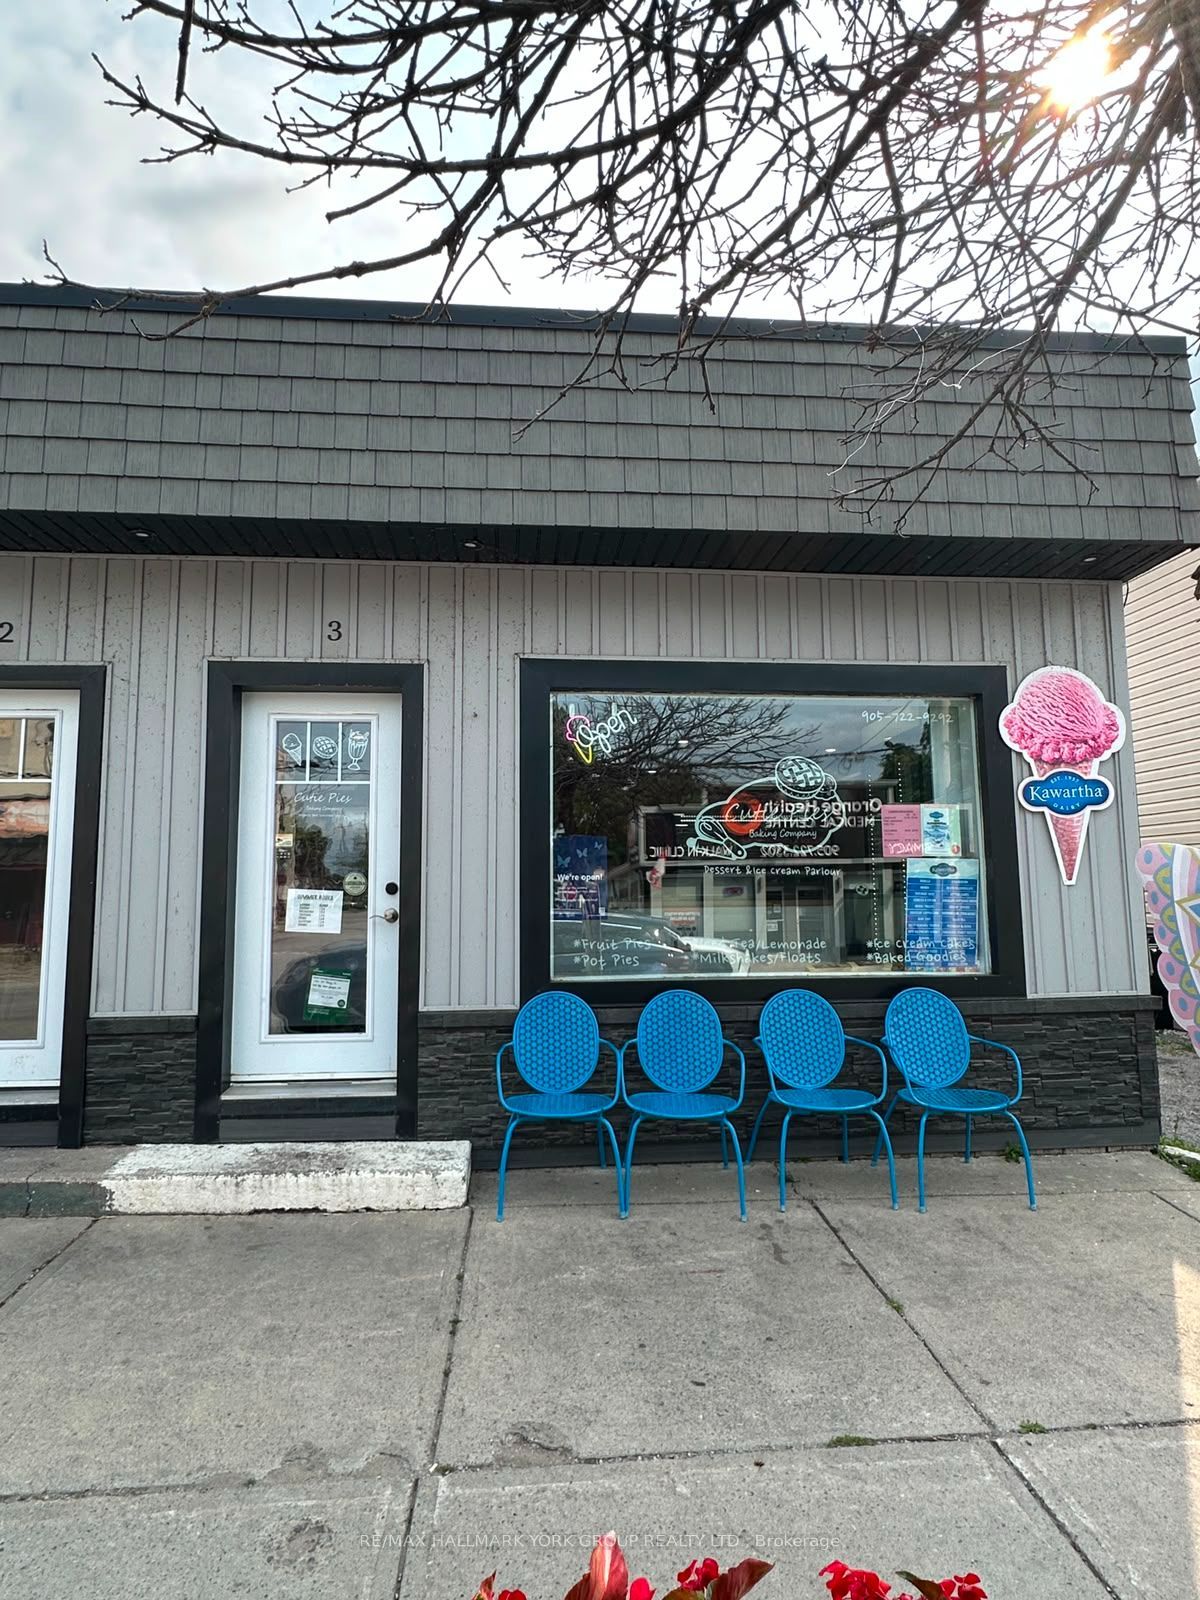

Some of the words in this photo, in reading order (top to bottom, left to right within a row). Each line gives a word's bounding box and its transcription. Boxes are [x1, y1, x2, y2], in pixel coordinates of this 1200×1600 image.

[0, 621, 14, 643] 2
[327, 620, 343, 642] 3
[861, 709, 955, 725] 905-722-9292
[576, 709, 638, 754] Open
[1029, 784, 1103, 802] Kawartha
[749, 829, 777, 840] Baking
[779, 829, 818, 839] Company
[557, 873, 580, 881] We're
[703, 865, 742, 875] Dessert
[805, 866, 842, 877] Parlour
[611, 953, 640, 967] Pies
